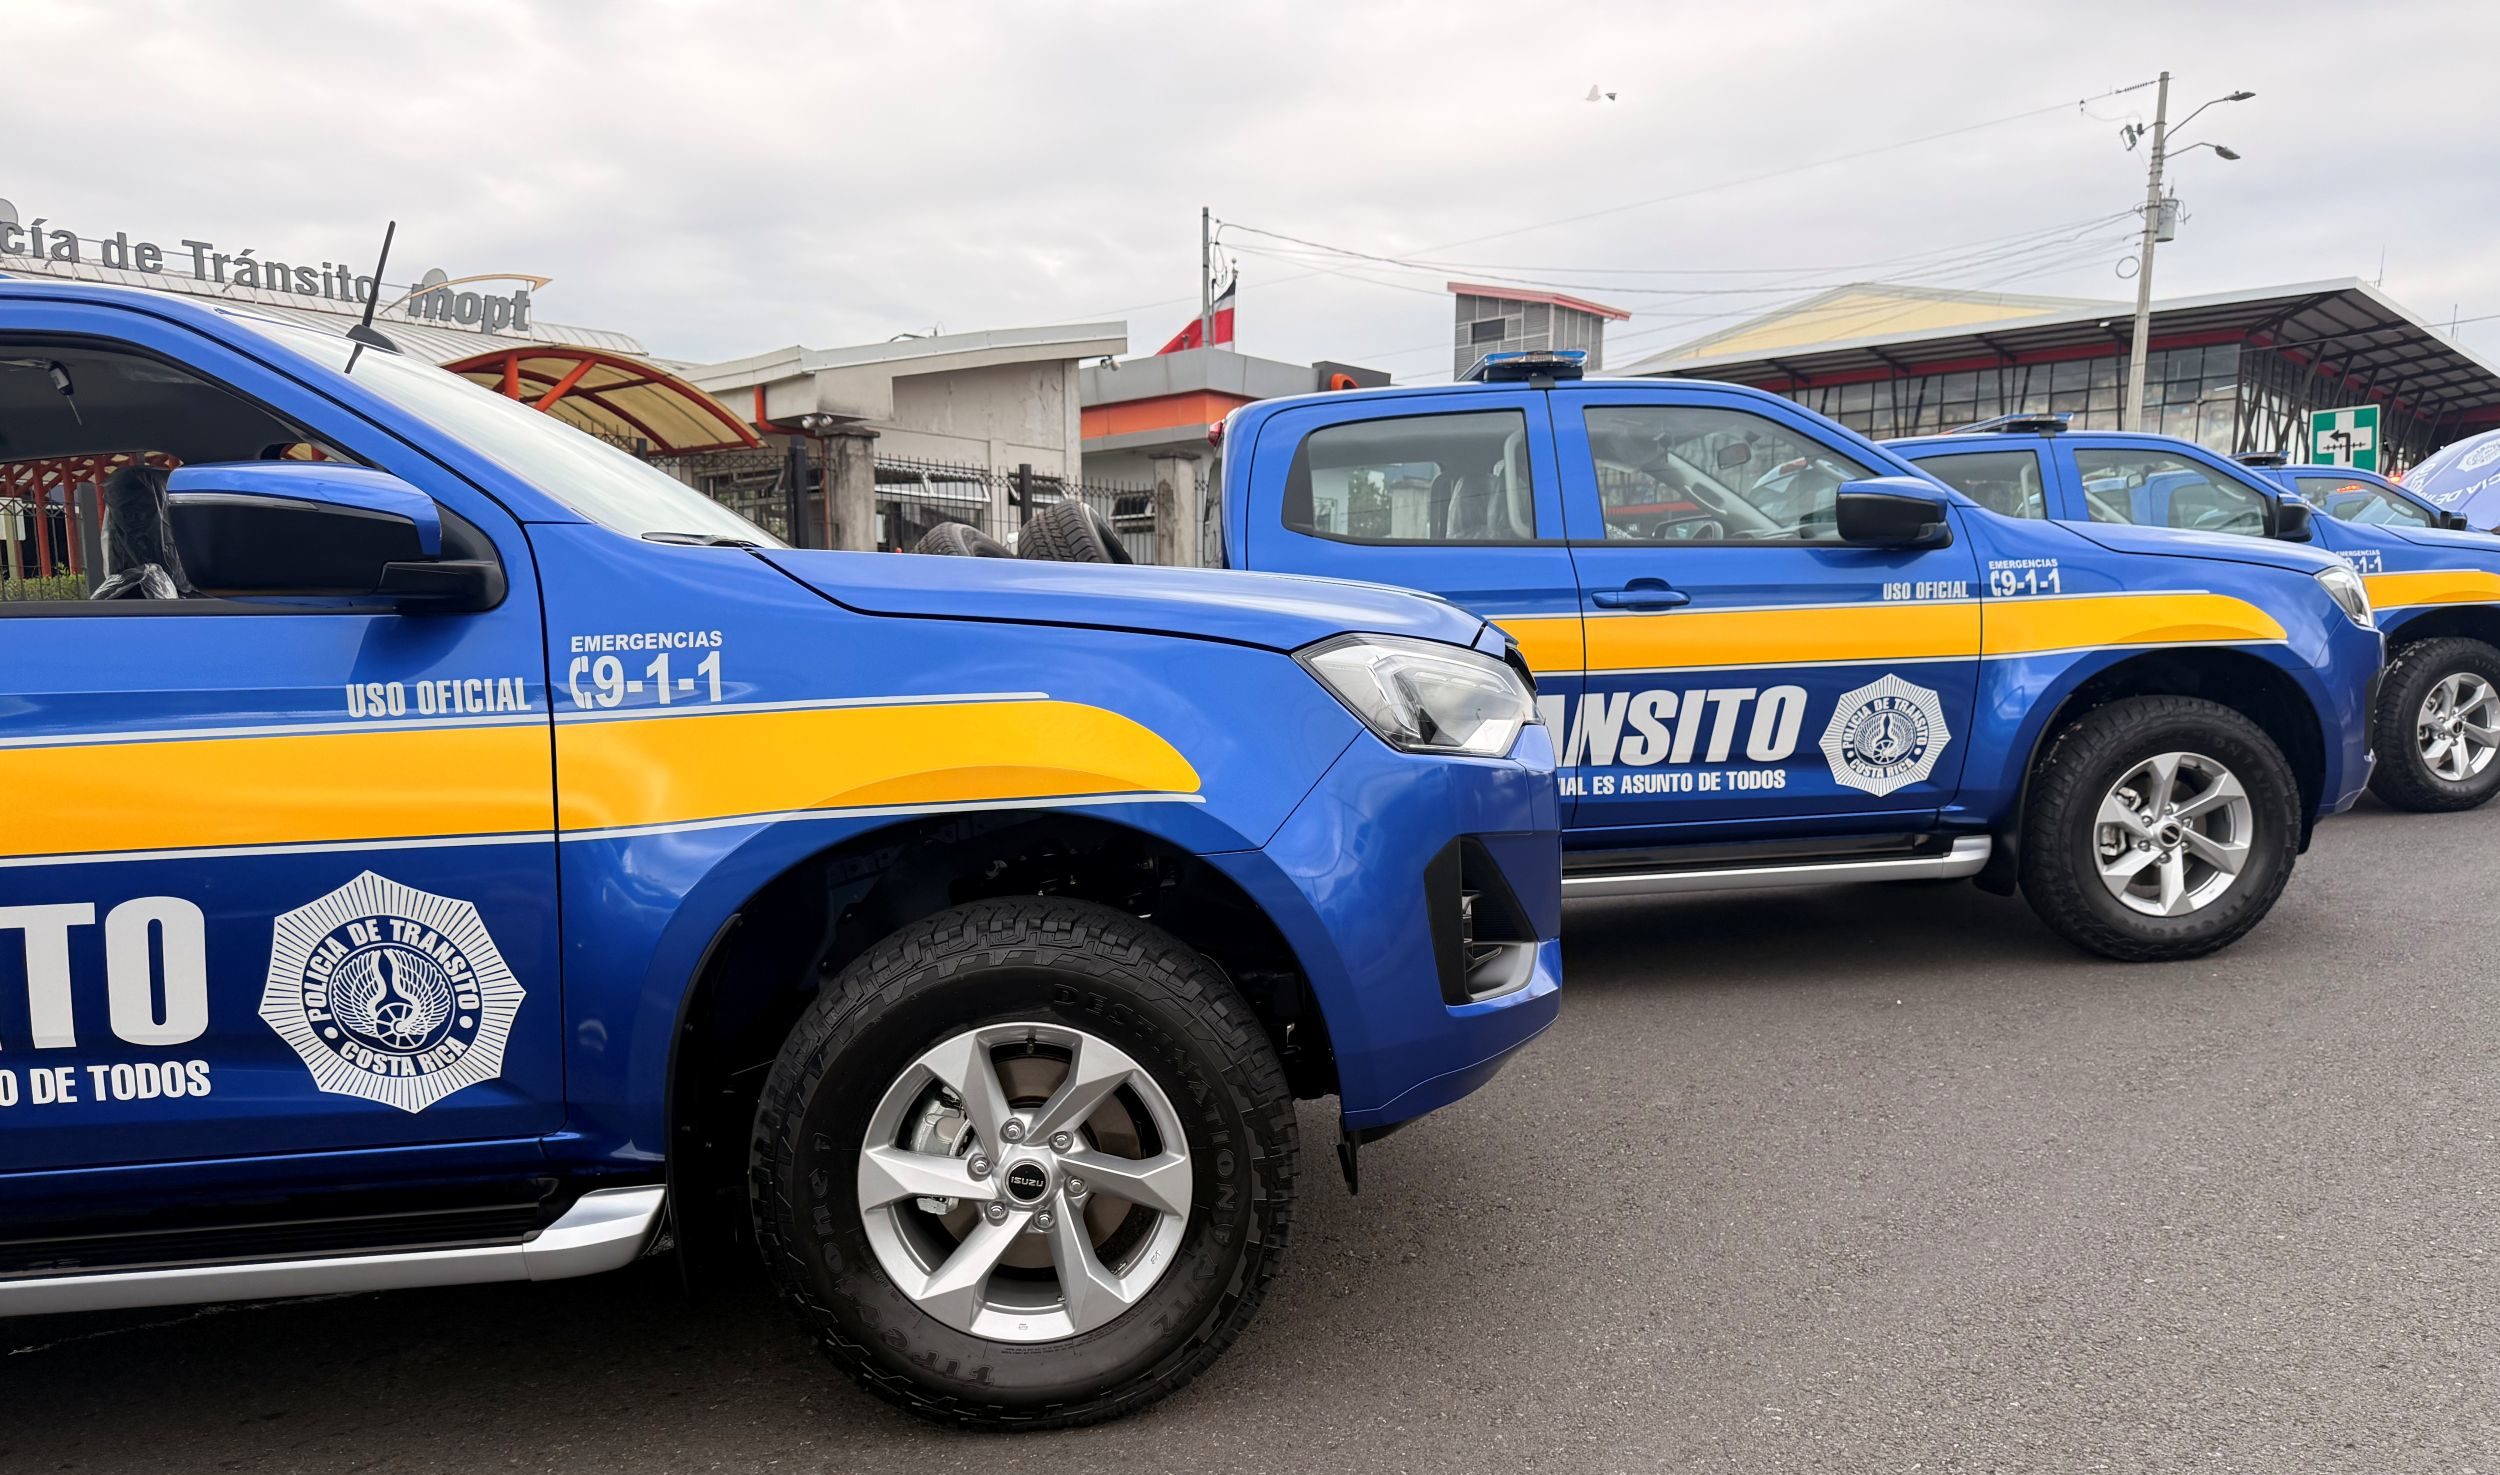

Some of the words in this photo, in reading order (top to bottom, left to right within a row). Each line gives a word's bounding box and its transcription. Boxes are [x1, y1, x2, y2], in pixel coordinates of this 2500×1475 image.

[0, 217, 81, 264] cía
[102, 231, 163, 274] de
[182, 239, 379, 305] Tránsito
[408, 283, 531, 335] mopt
[1988, 558, 2058, 570] EMERGENCIAS
[2001, 568, 2061, 597] 9-1-1
[1882, 581, 1911, 601] USO
[1915, 580, 1969, 600] OFICIAL
[571, 630, 723, 653] EMERGENCIAS
[345, 680, 406, 718] USO
[417, 676, 532, 715] OFICIAL
[593, 651, 723, 708] 9-1-1
[1842, 705, 1872, 749] POLICIA
[1873, 698, 1890, 711] DE
[1894, 698, 1928, 746] TRANSITO
[1557, 776, 1588, 796] IAL
[1592, 775, 1615, 795] ES
[1620, 773, 1693, 794] ASUNTO
[1698, 771, 1721, 792] DE
[1726, 769, 1786, 791] TODOS
[1849, 759, 1884, 778] COSTA
[1885, 757, 1916, 777] RICA
[0, 896, 209, 1050] TO
[304, 935, 350, 1023] POLICIA
[346, 919, 382, 947] DE
[389, 918, 481, 1010] TRANSITO
[339, 1040, 418, 1077] COSTA
[420, 1035, 470, 1074] RICA
[29, 1066, 78, 1105] DE
[86, 1059, 212, 1102] TODOS
[1010, 1176, 1044, 1187] ISUZU
